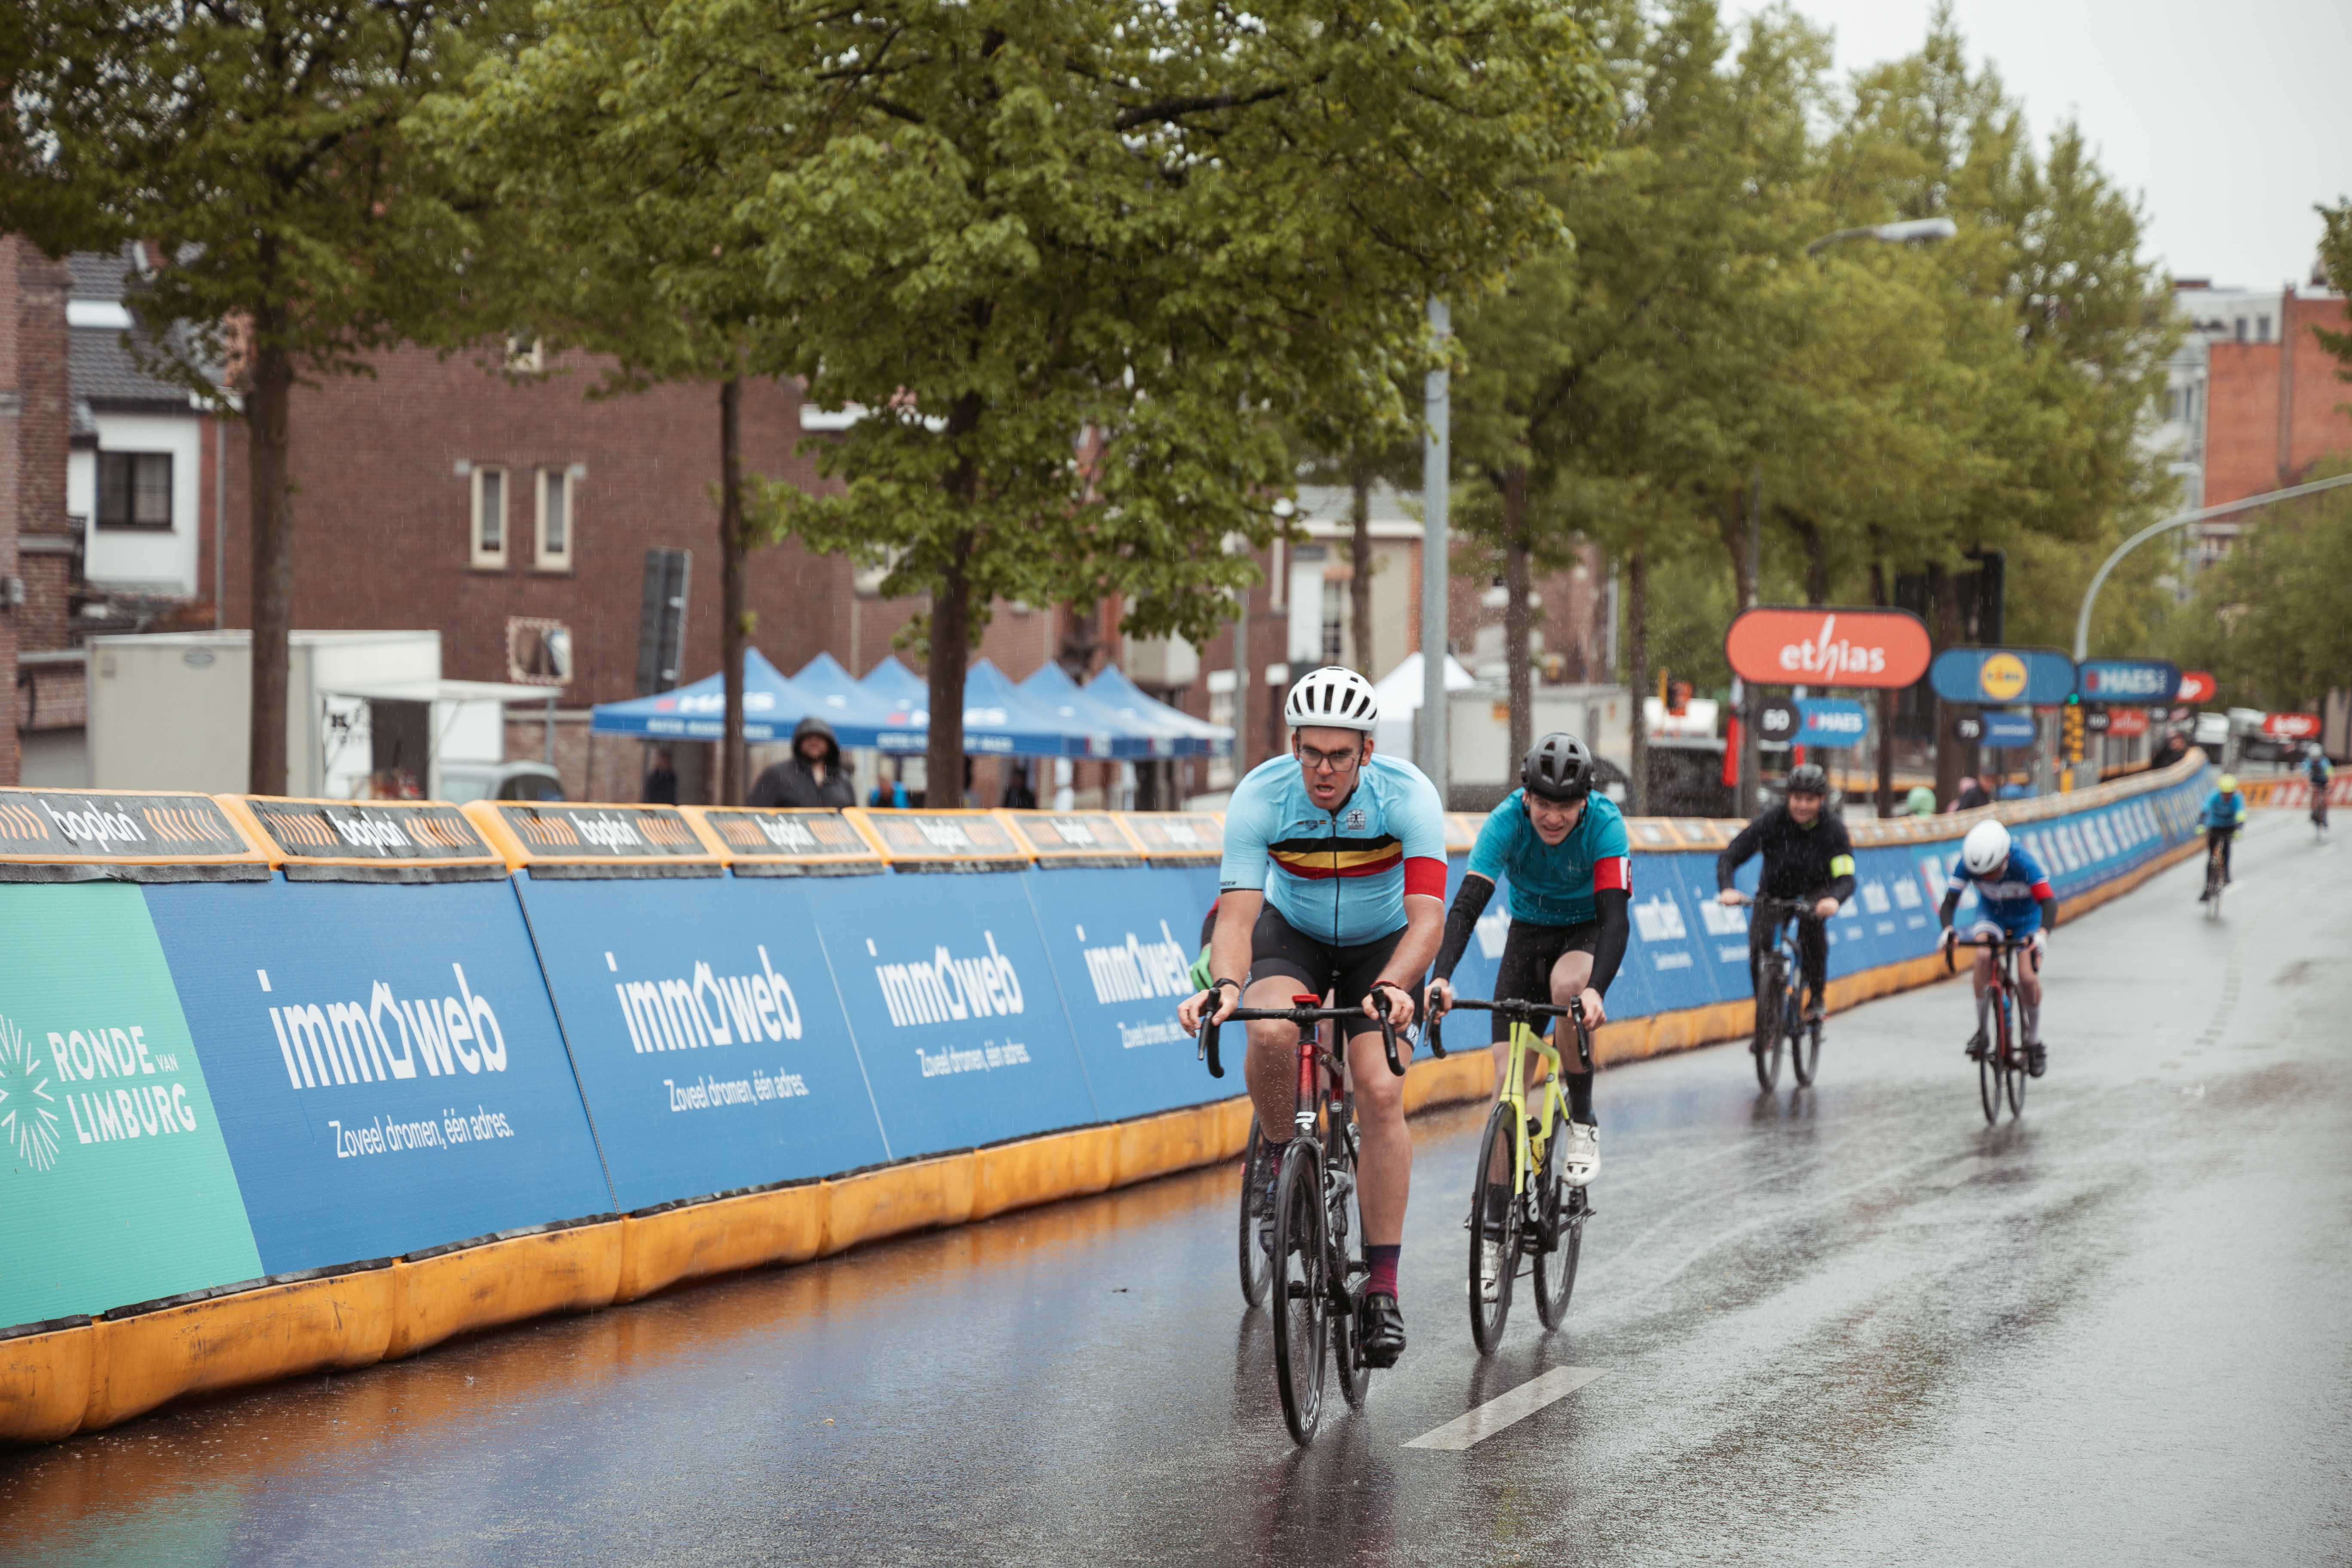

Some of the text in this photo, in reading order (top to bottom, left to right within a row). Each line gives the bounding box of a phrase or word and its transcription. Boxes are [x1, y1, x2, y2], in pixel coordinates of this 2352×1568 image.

[1779, 613, 1886, 682] ethias
[1816, 712, 1864, 732] MAES
[39, 799, 147, 852] boplan
[326, 810, 411, 856] boplan
[569, 811, 642, 854] boplan
[865, 930, 1024, 1027] immoweb
[1075, 920, 1194, 1004] immoweb
[257, 962, 507, 1089] immoweb
[605, 944, 802, 1054] immoweb
[47, 1026, 179, 1082] RONDE VAN
[66, 1083, 196, 1144] LIMBURG
[663, 1075, 710, 1112] Zoveel
[708, 1074, 758, 1106] dromen,
[328, 1104, 514, 1158] Zoveel dromen, één adres.
